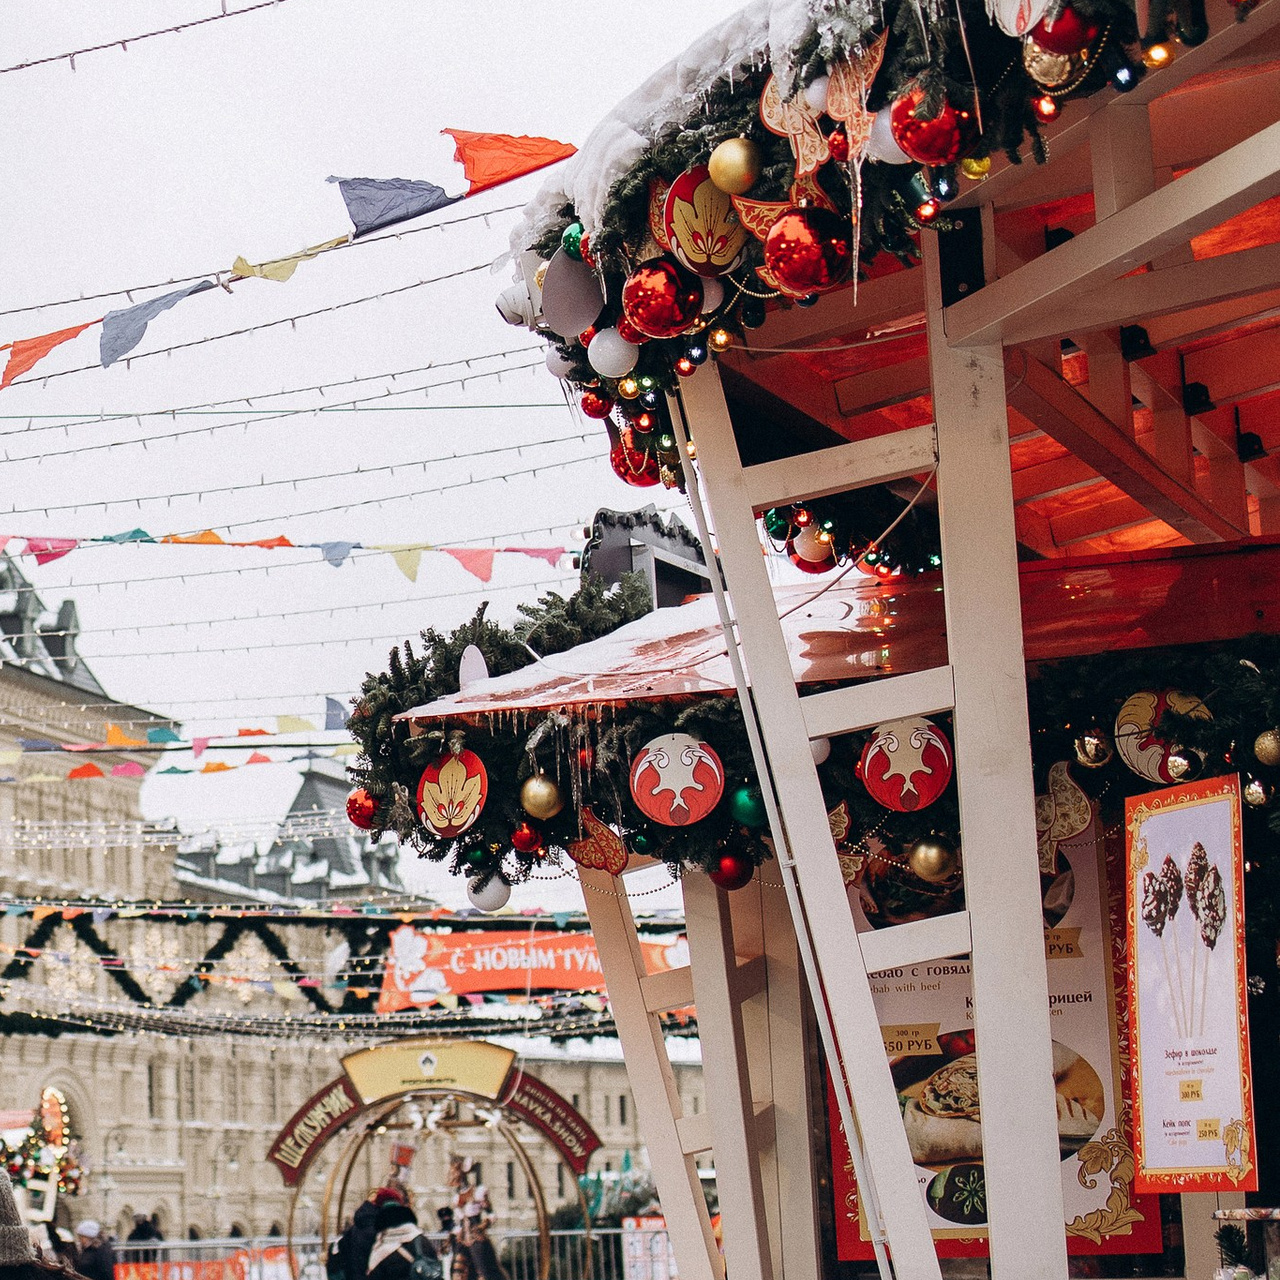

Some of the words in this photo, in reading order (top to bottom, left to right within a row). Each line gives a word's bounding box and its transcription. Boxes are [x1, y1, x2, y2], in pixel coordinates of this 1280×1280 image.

[1048, 943, 1074, 955] РУБ
[450, 951, 468, 975] С
[475, 946, 556, 971] НОВЫМ
[895, 981, 916, 993] with
[920, 980, 941, 992] beef
[1048, 990, 1093, 1008] рицей
[907, 1039, 933, 1051] РУБ
